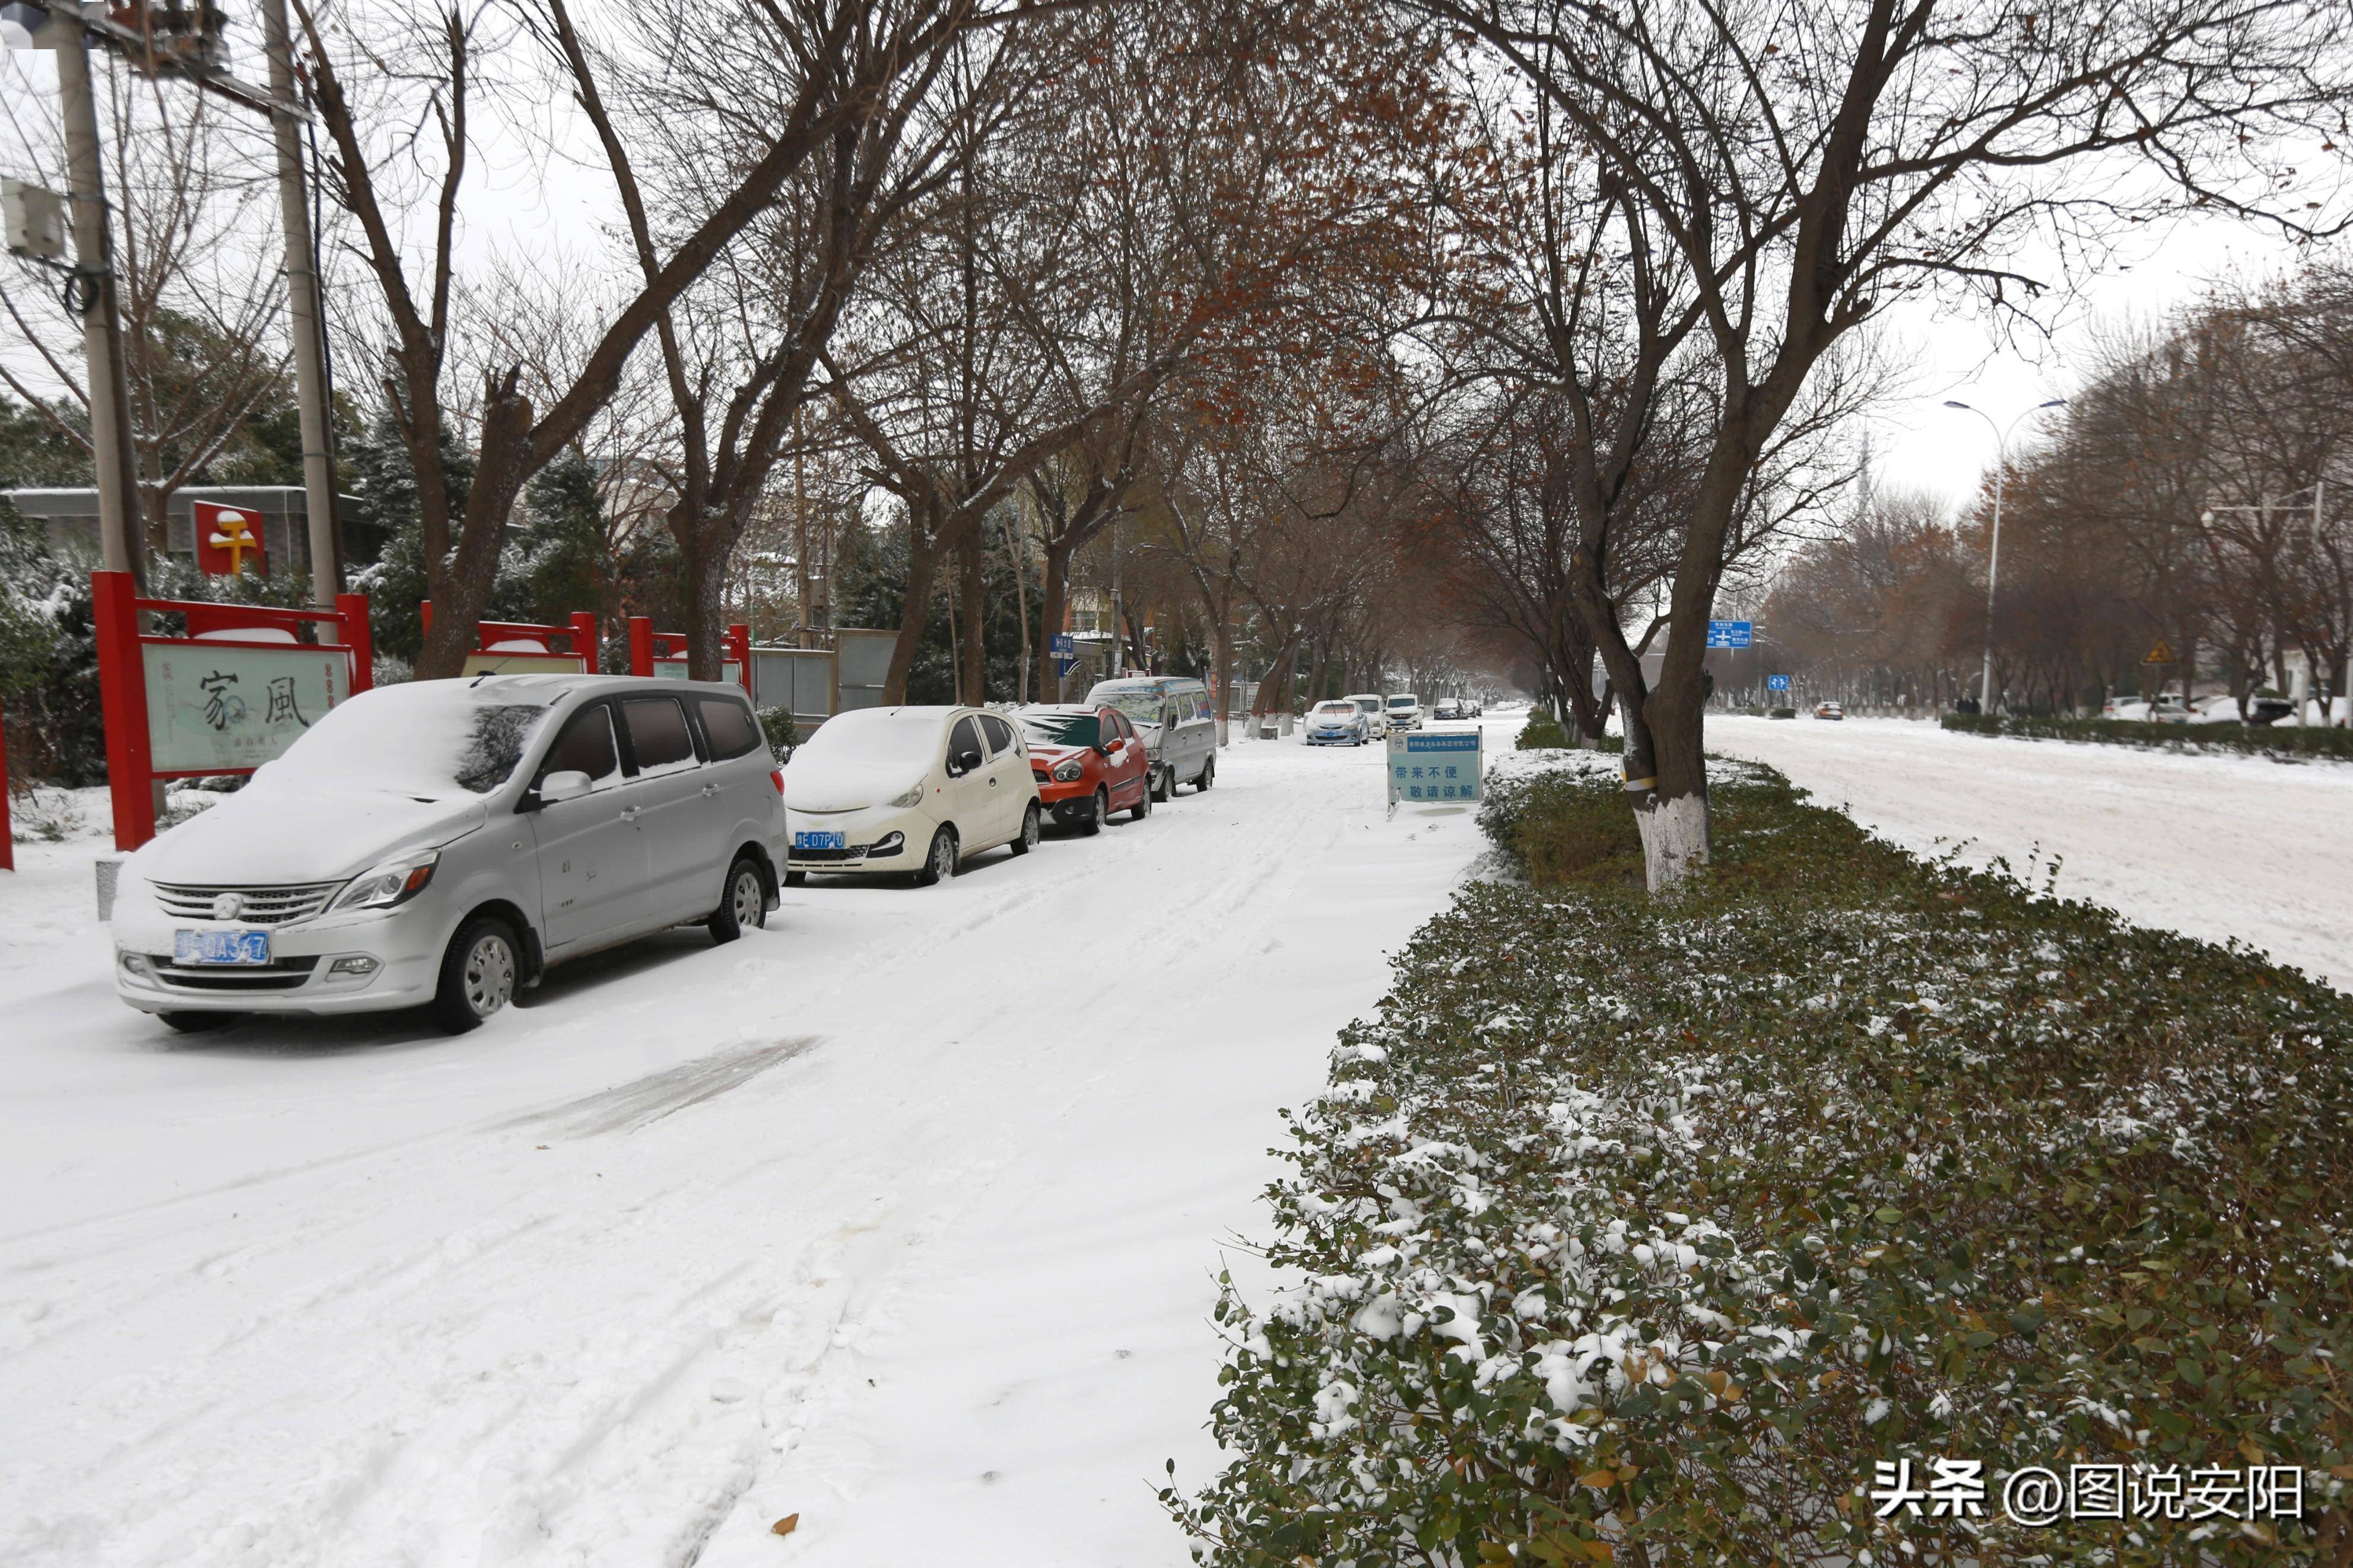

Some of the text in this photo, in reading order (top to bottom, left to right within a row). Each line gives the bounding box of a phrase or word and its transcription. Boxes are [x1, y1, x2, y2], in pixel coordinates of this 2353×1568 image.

[1396, 766, 1457, 779] 带来不便
[1410, 785, 1473, 798] 敬请谅解
